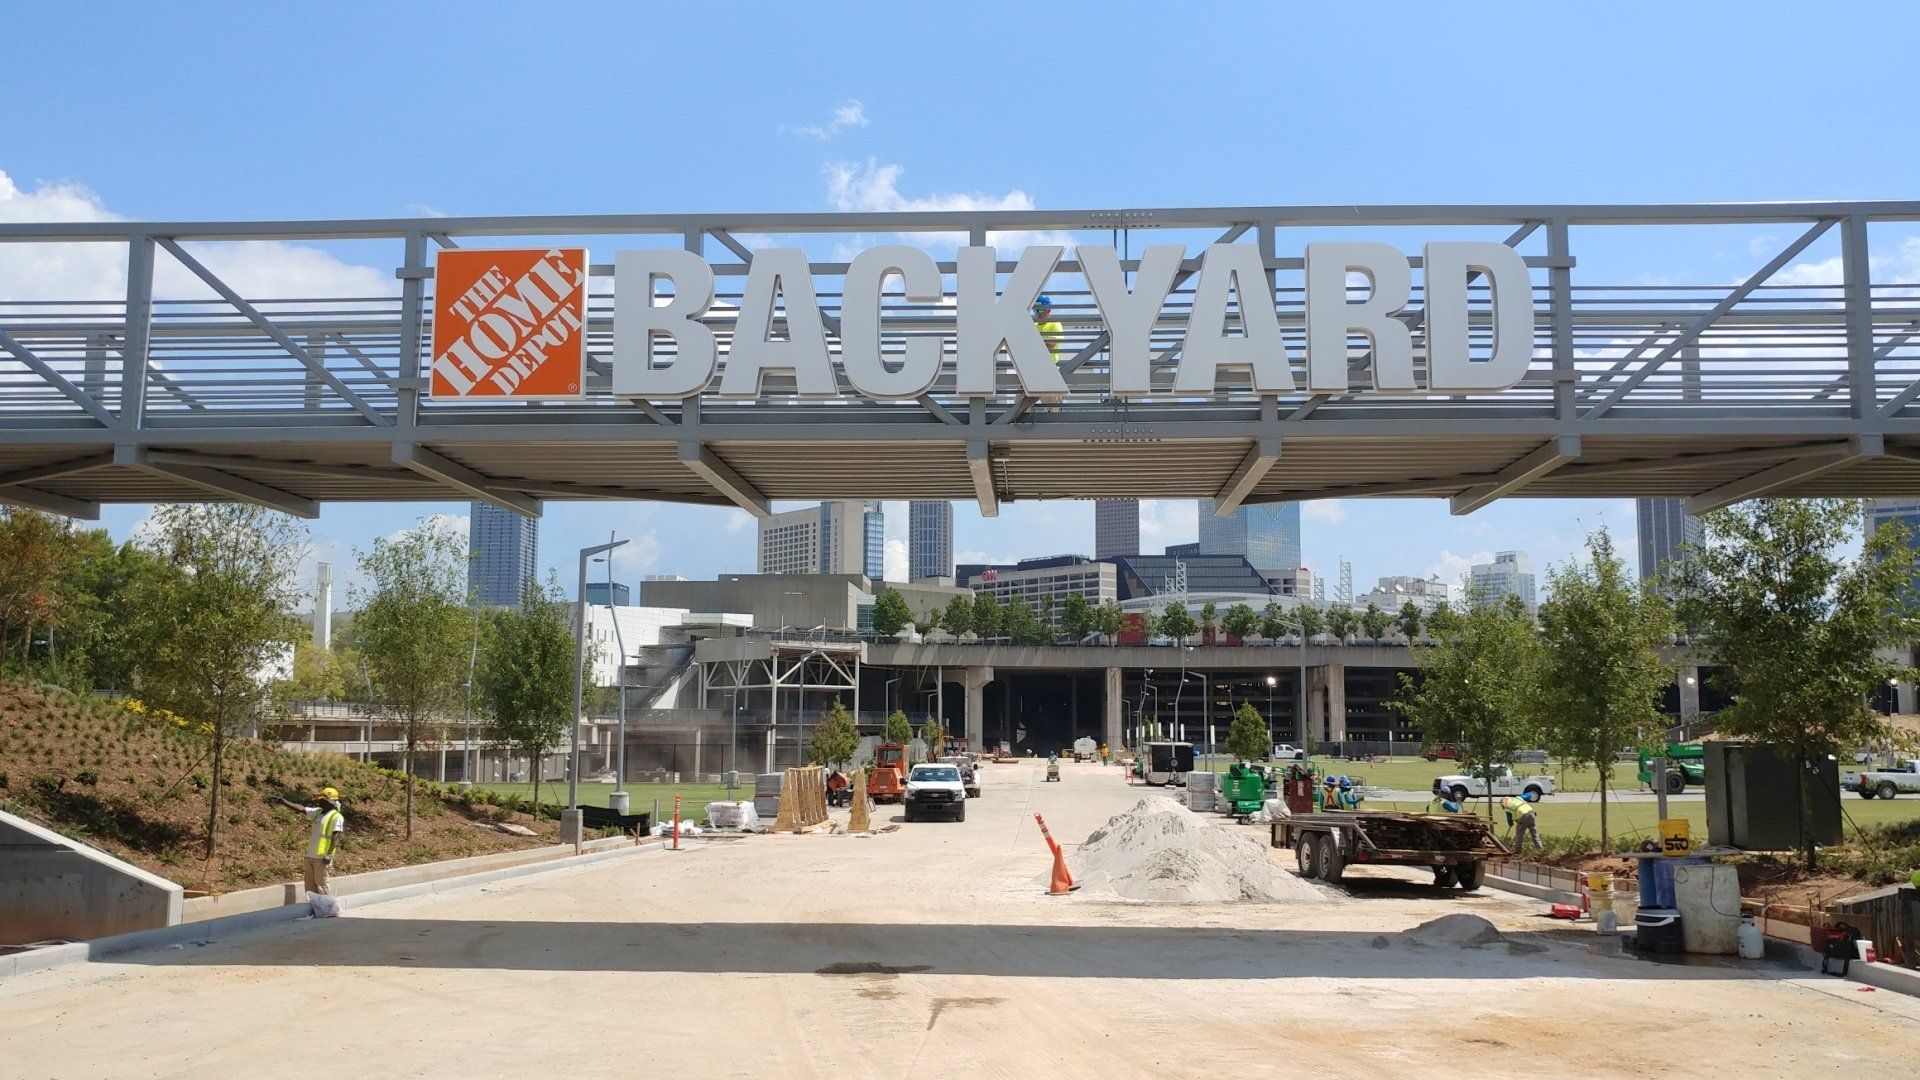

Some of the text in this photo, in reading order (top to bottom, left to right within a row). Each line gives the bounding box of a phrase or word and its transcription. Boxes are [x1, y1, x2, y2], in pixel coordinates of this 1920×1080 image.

[434, 249, 583, 395] HOME
[449, 264, 511, 323] THE
[490, 303, 582, 395] DEPOT
[612, 241, 1534, 399] BACKYARD
